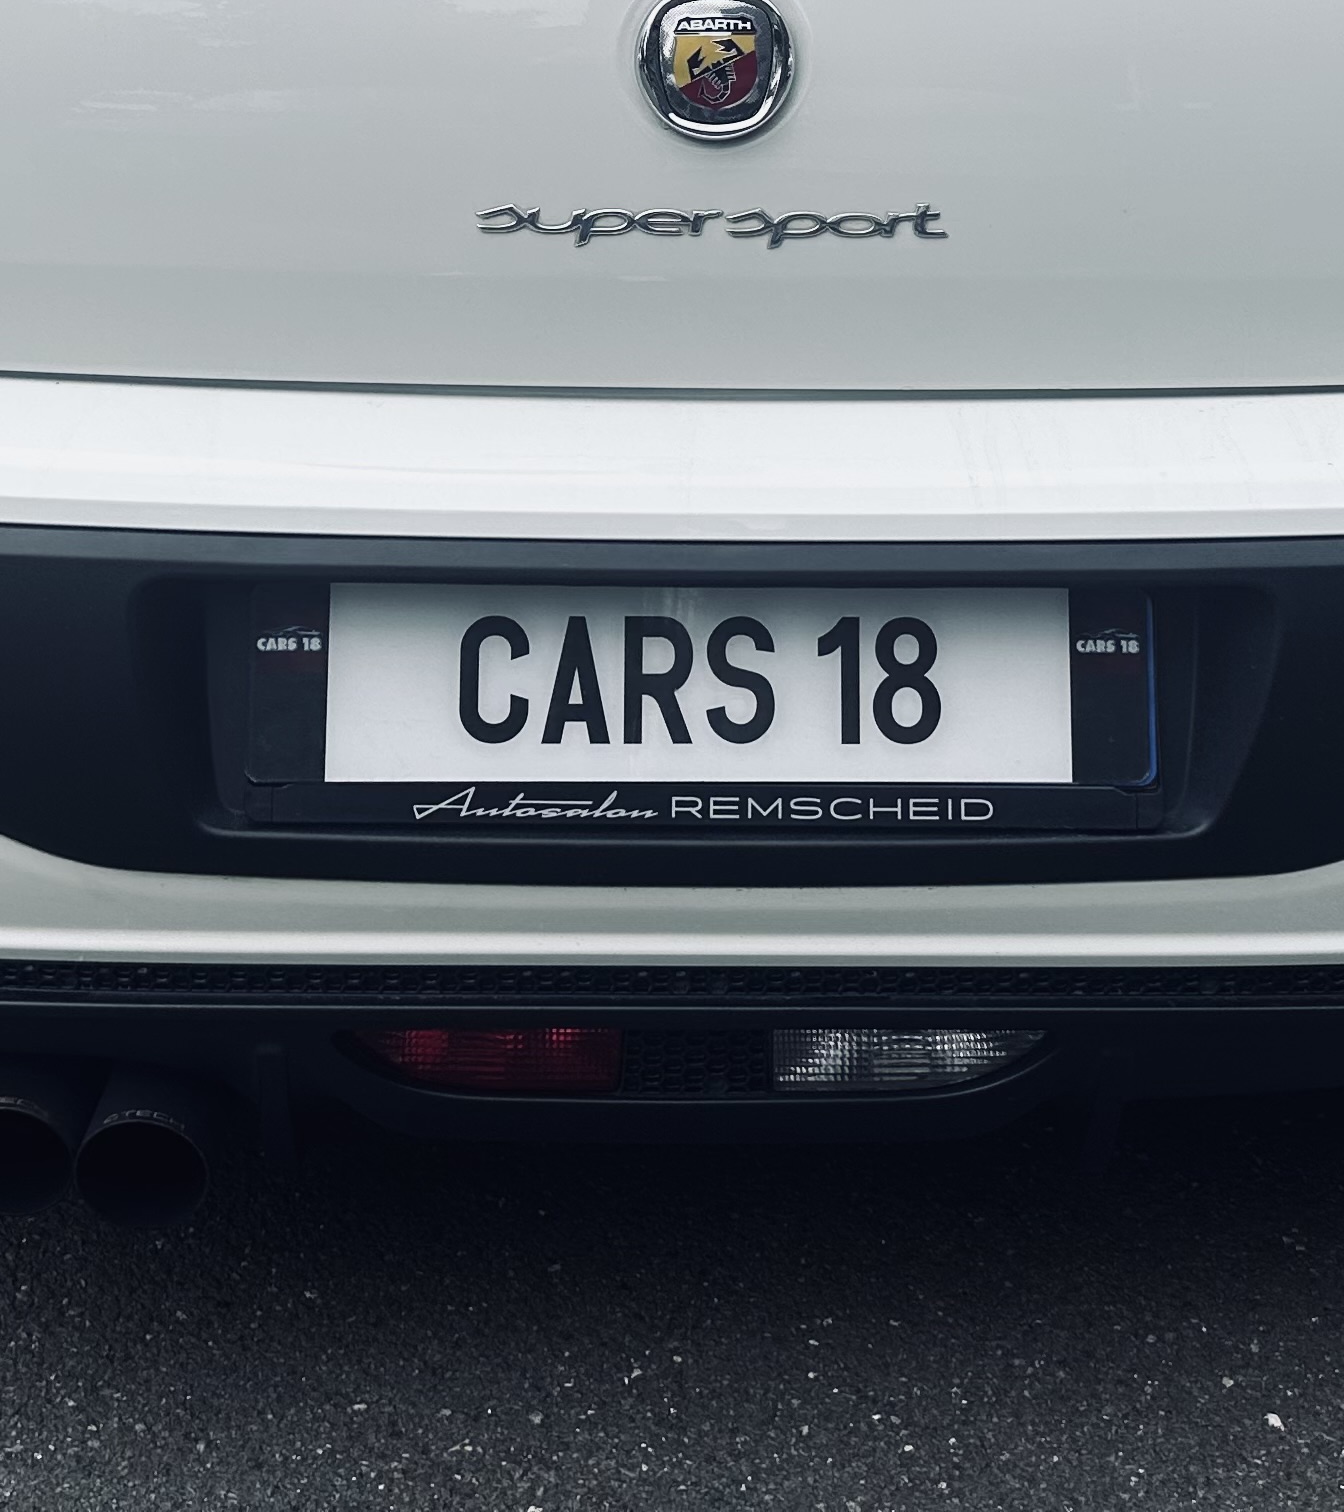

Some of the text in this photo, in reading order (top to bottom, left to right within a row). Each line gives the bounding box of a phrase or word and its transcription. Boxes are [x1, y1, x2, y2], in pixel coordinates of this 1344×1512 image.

[677, 18, 752, 31] ABARTH
[256, 636, 323, 652] CARS 18
[1076, 639, 1140, 654] CARS 18
[458, 614, 942, 745] CARS 18
[413, 786, 994, 821] Autosalon REMSCHEID
